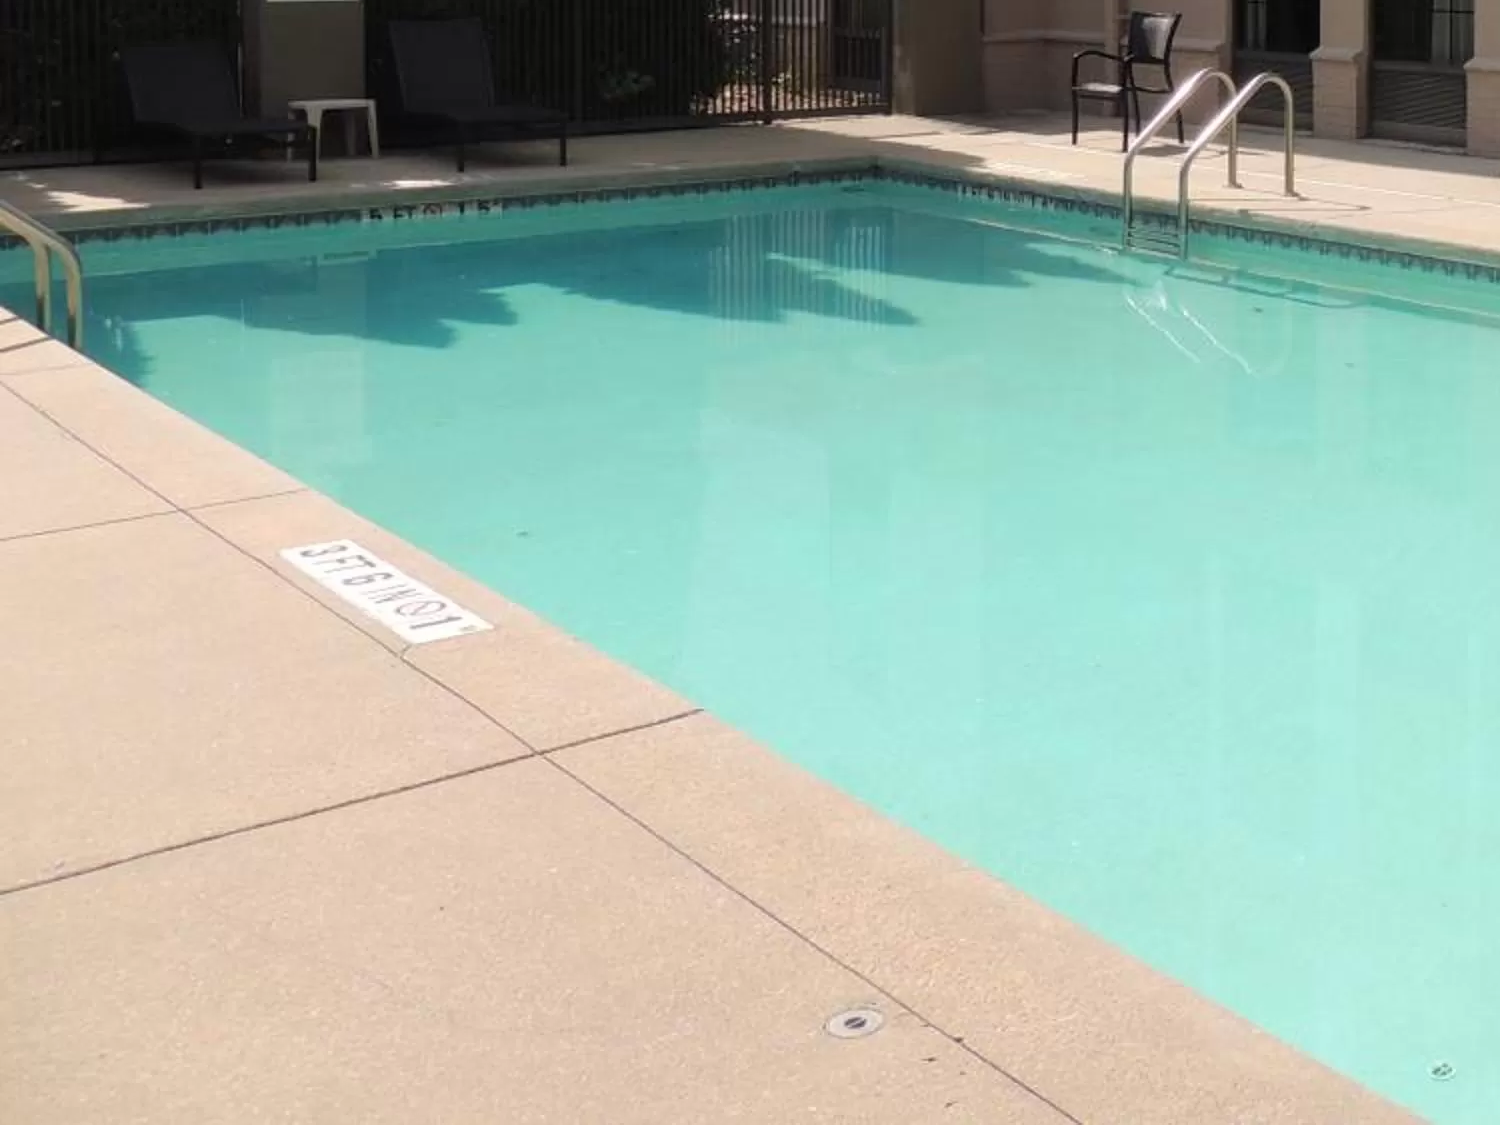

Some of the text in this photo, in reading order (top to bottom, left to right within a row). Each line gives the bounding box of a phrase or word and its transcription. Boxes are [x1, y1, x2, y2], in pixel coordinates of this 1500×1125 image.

[299, 544, 348, 558] 3
[312, 554, 377, 574] FT
[341, 571, 394, 586] 6
[361, 582, 423, 605] IN
[408, 615, 463, 630] 1
